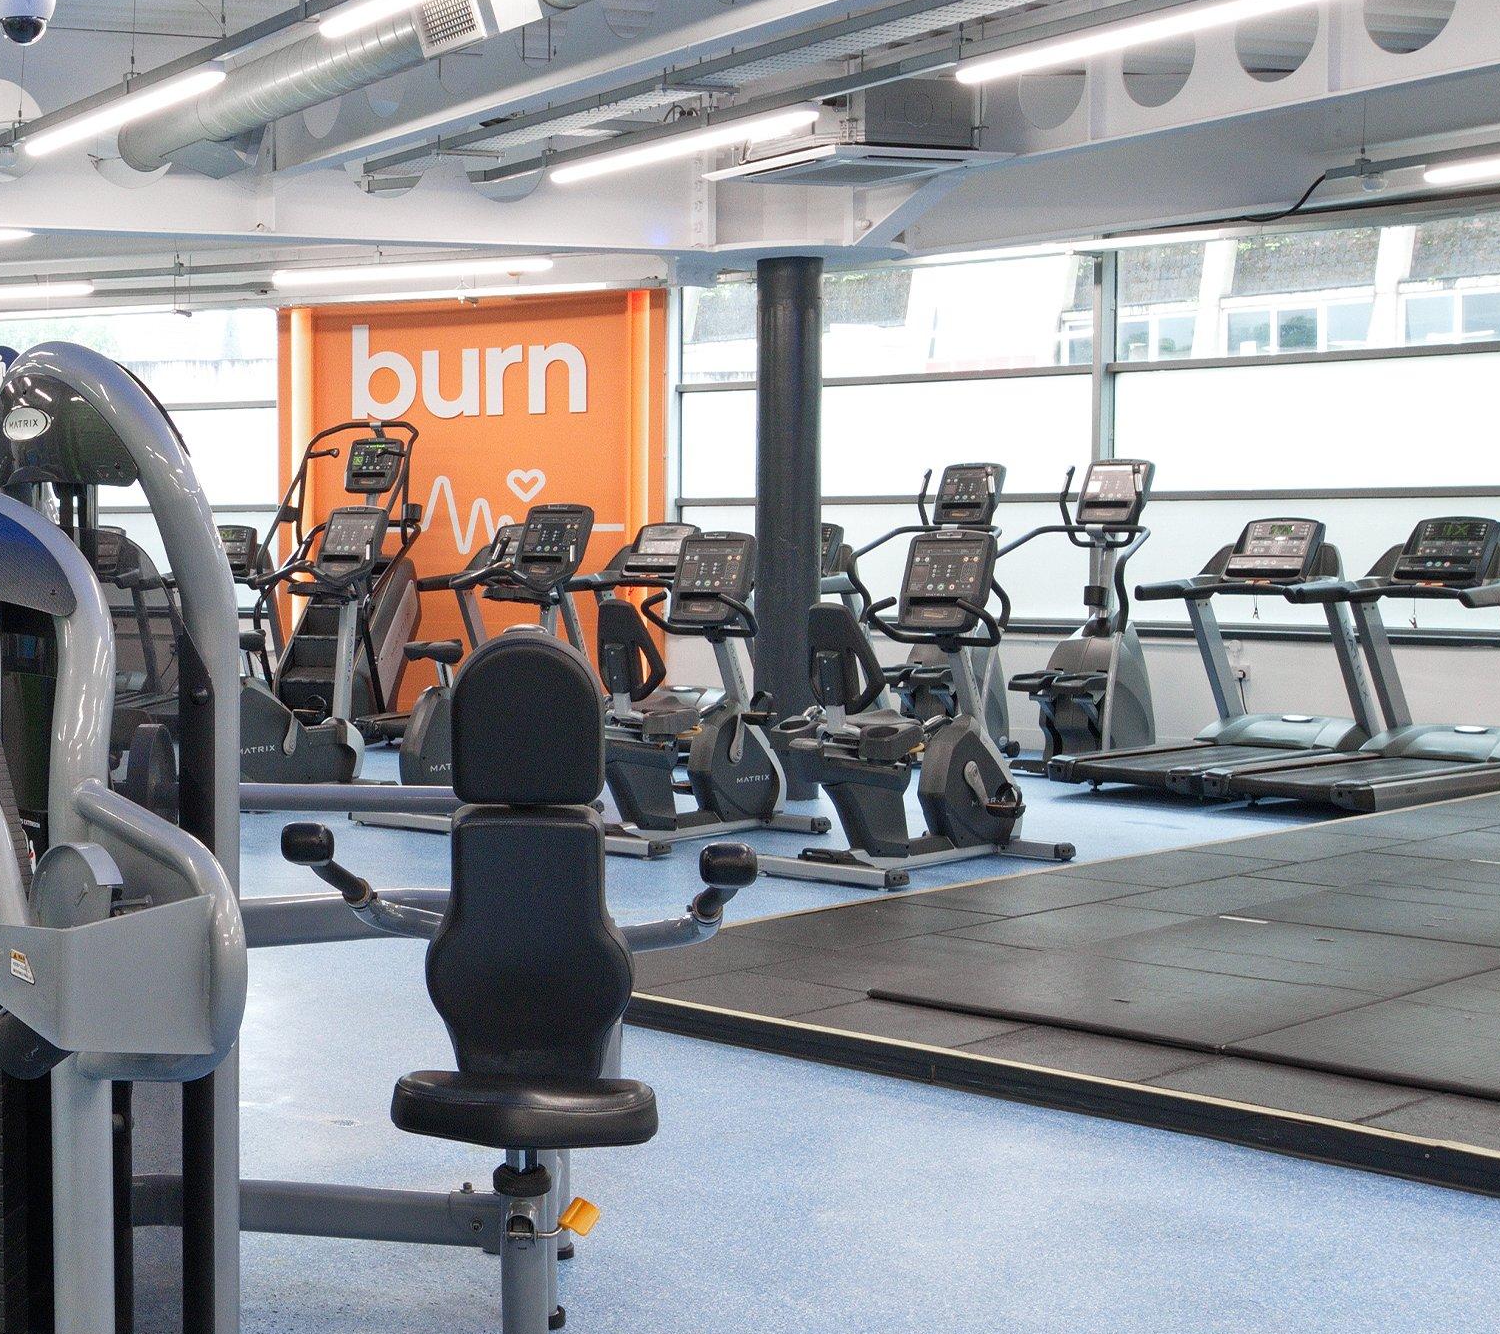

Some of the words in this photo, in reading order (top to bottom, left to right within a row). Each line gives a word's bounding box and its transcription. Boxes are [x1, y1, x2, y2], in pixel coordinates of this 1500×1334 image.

[352, 324, 589, 420] burn
[8, 419, 39, 429] MATRIX
[736, 774, 770, 784] MATRIX
